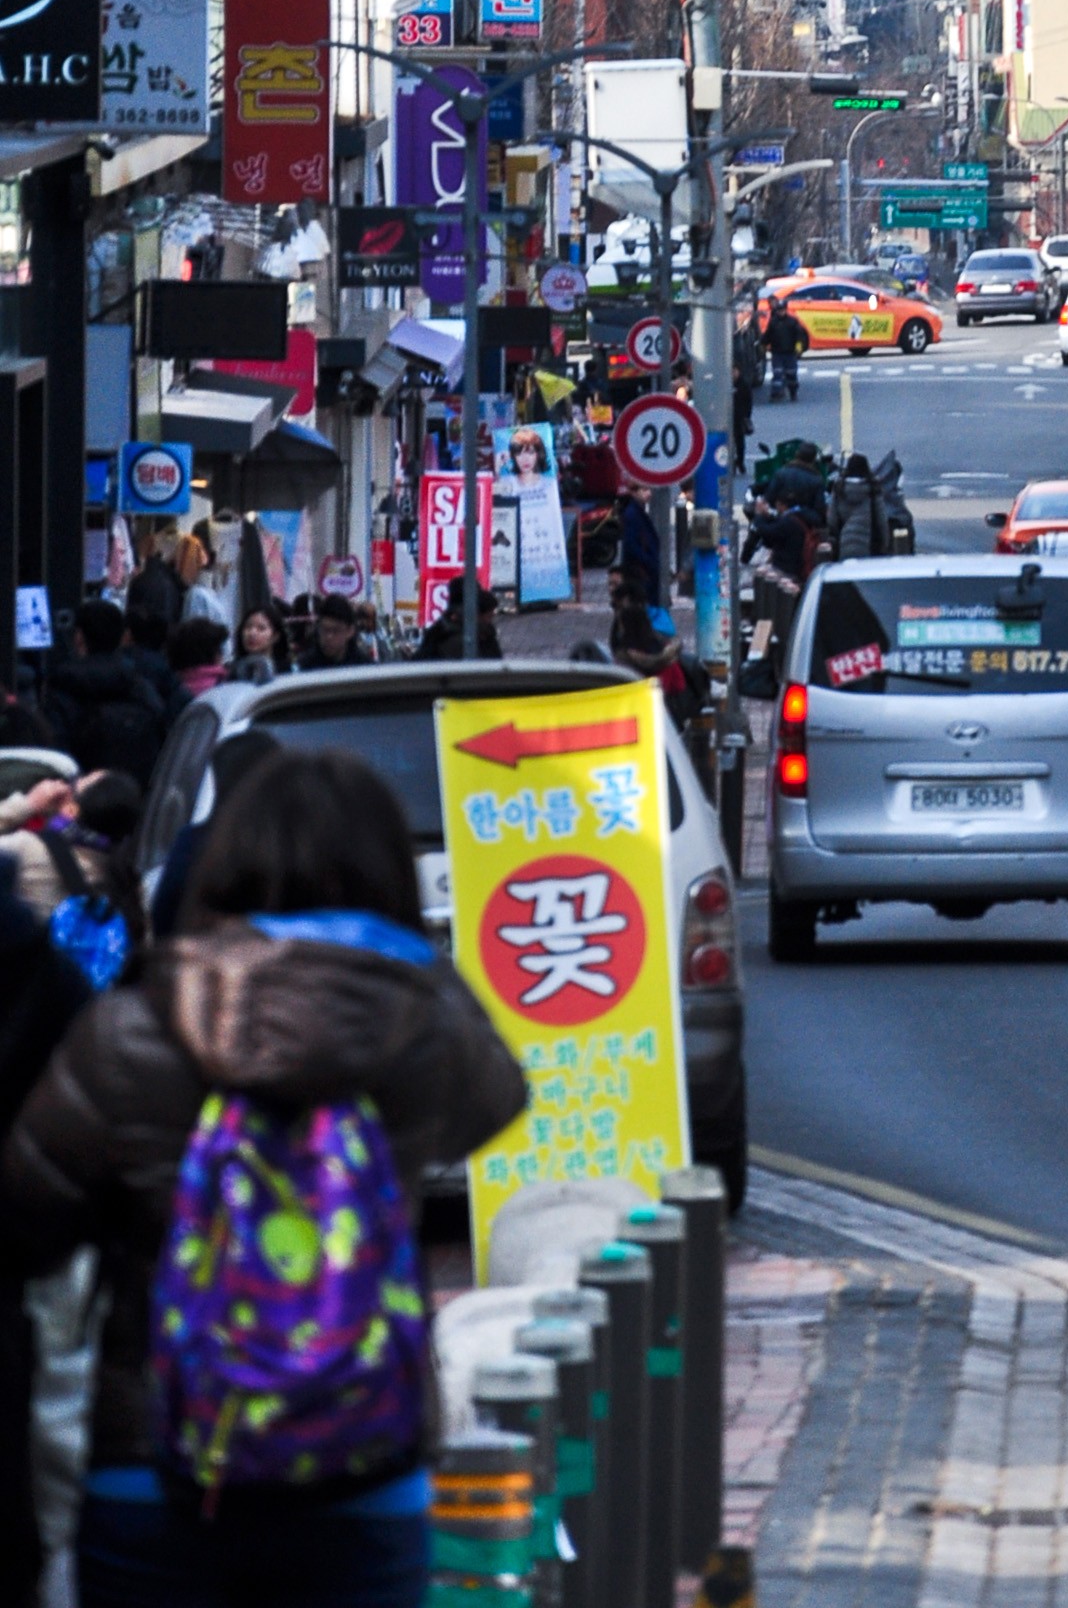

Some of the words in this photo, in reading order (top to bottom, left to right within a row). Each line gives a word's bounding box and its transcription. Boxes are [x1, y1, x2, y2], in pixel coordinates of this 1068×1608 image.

[399, 15, 442, 44] 33
[641, 423, 681, 459] 20
[467, 791, 579, 839] 한아름
[590, 764, 639, 836] 꽃
[498, 870, 628, 1006] 꽃
[526, 1070, 631, 1110] 바구니
